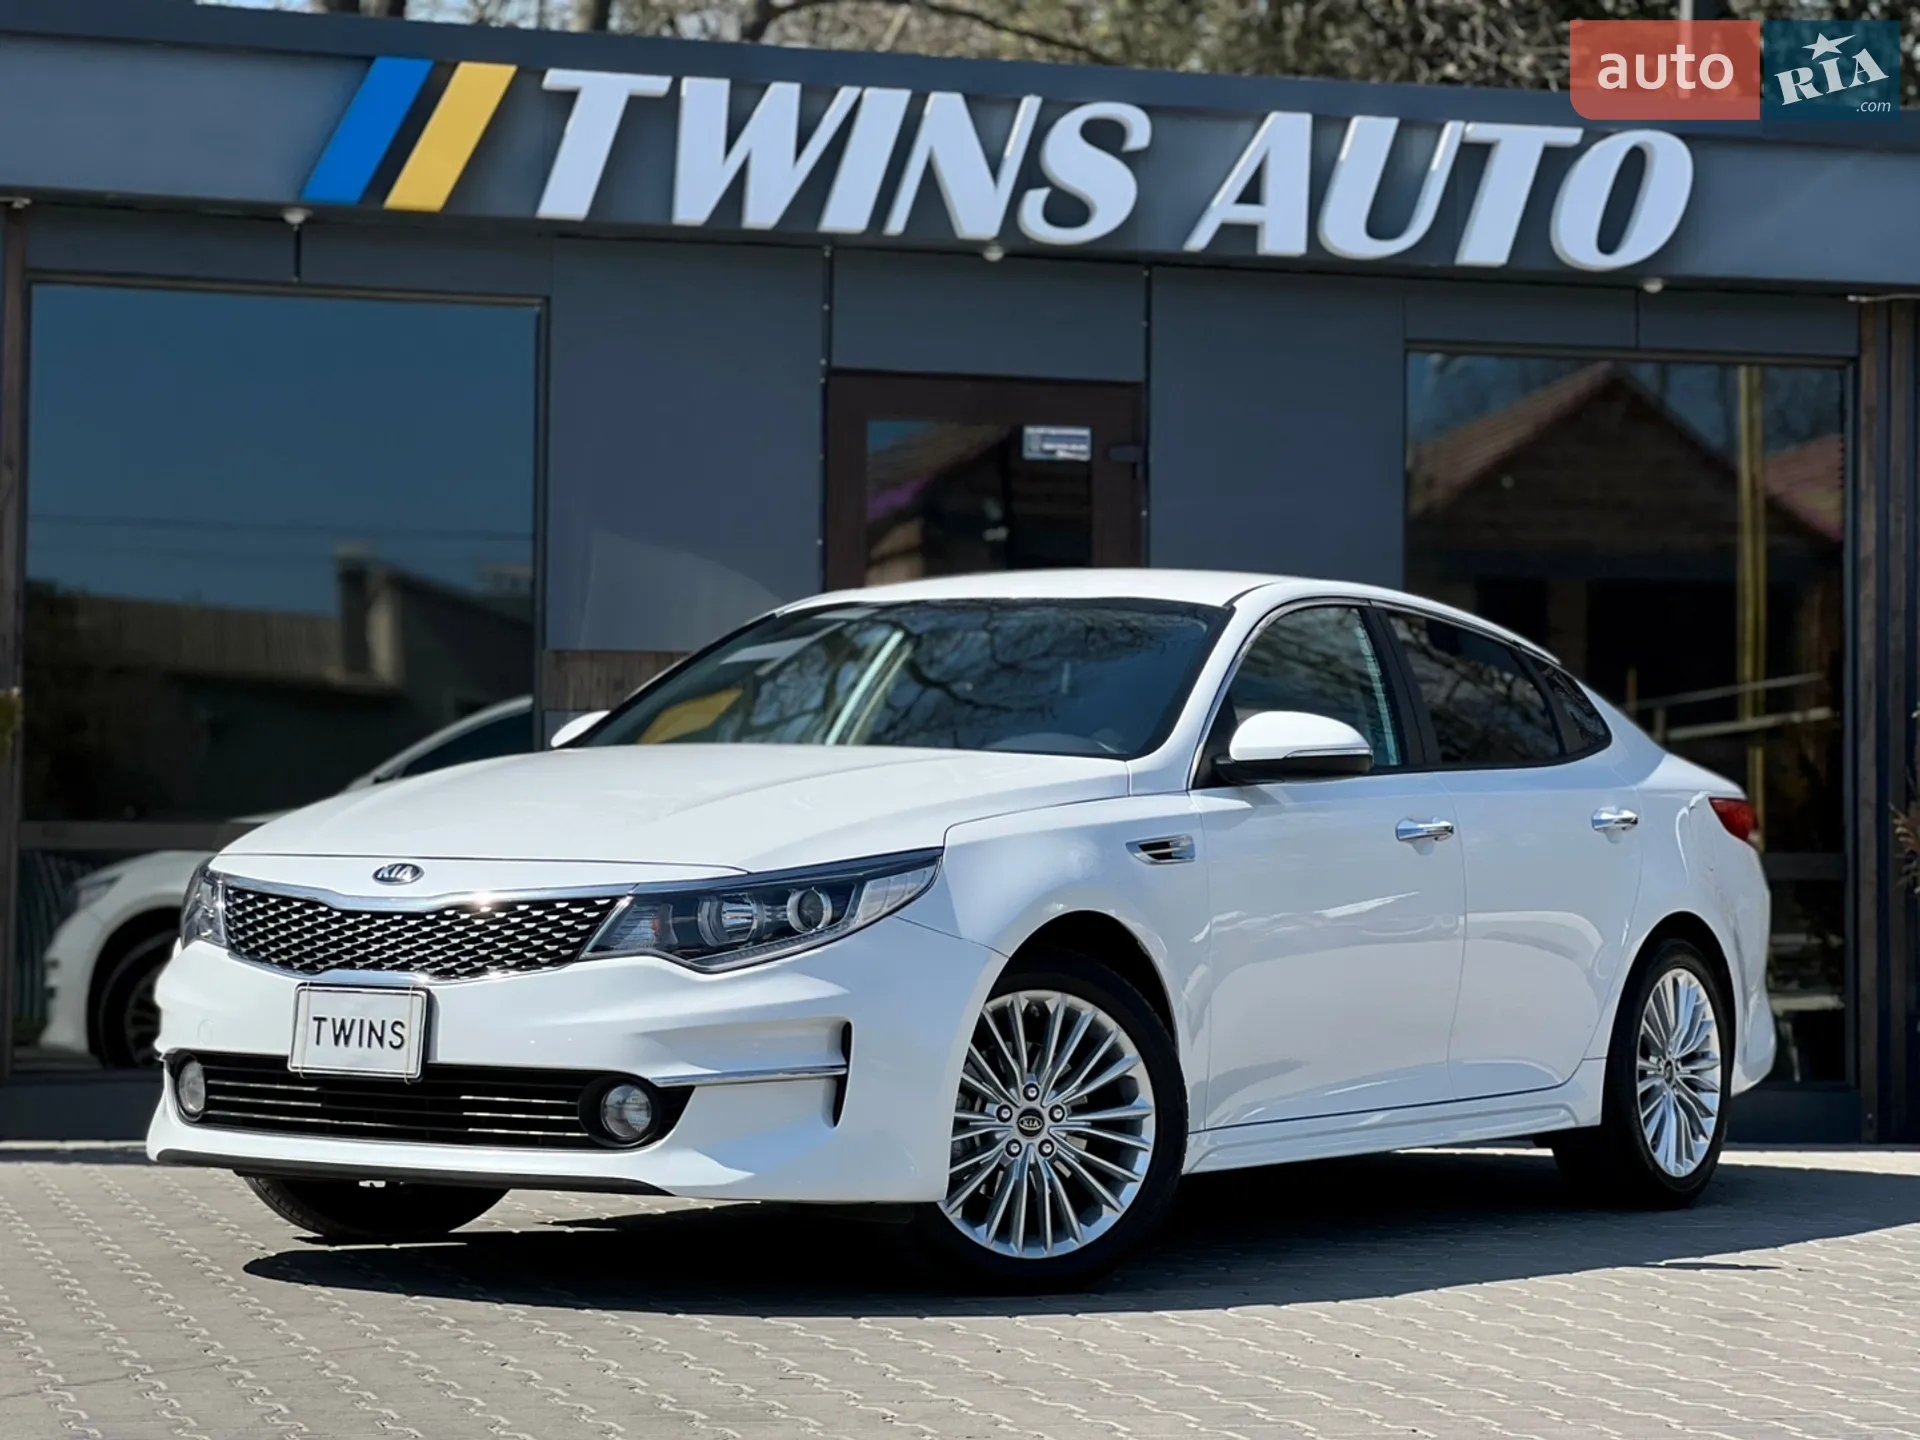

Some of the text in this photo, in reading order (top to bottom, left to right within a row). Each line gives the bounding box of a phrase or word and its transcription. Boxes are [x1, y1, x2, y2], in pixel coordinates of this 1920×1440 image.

[536, 68, 1694, 271] TWINS AUTO
[313, 1016, 406, 1050] TWINS
